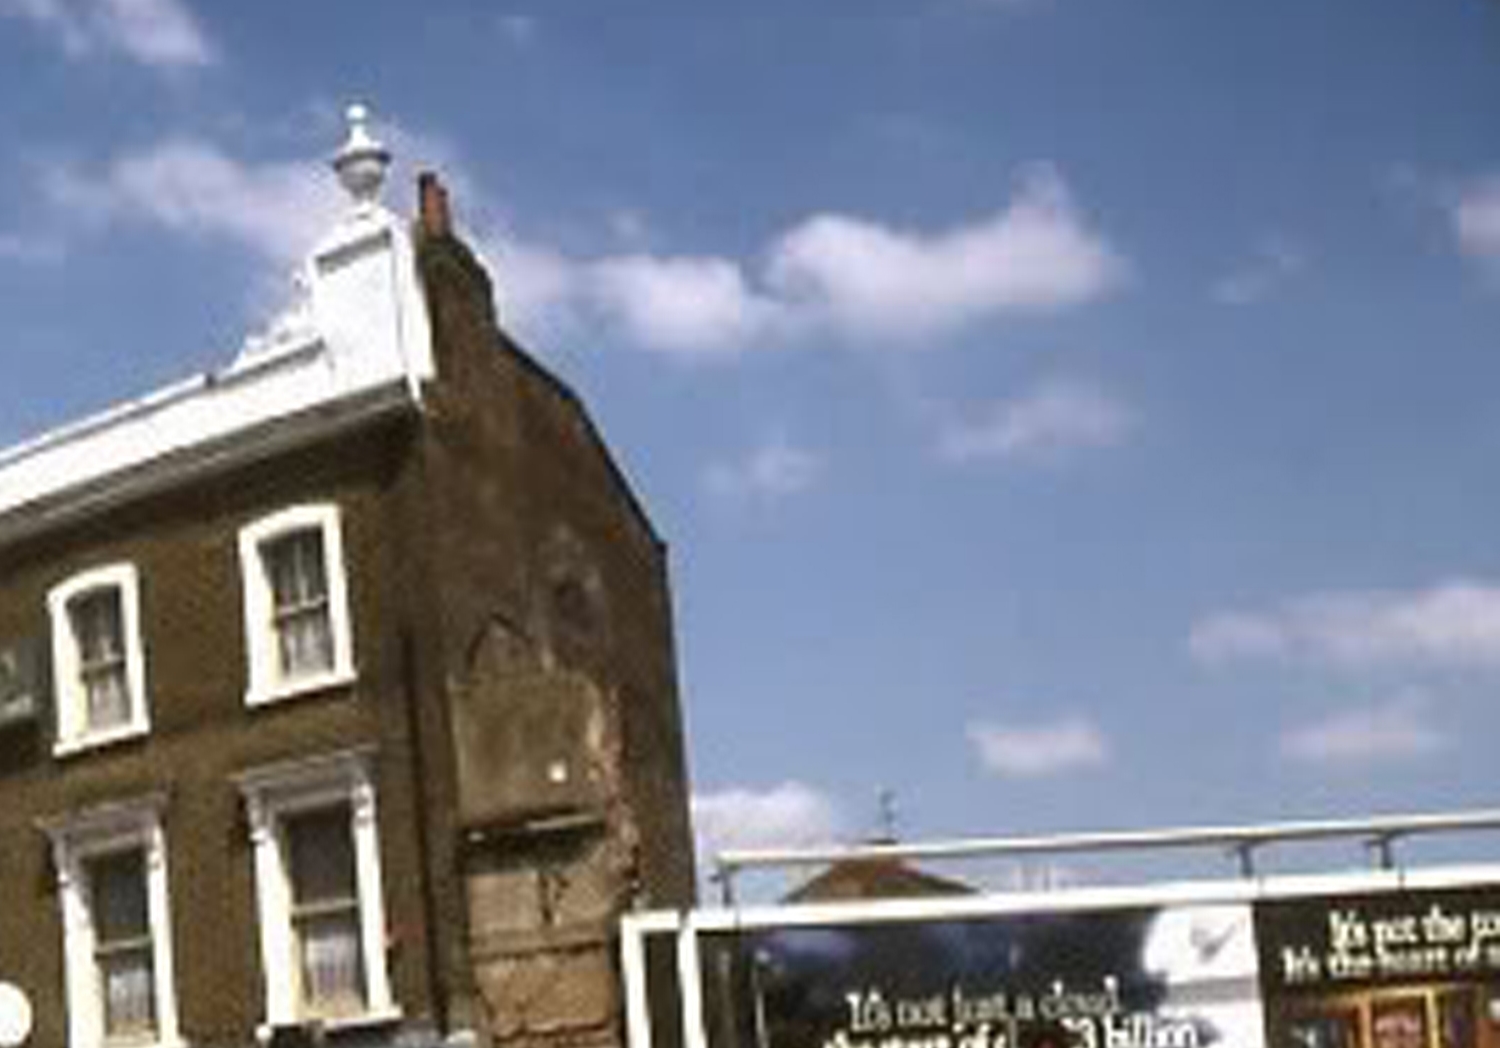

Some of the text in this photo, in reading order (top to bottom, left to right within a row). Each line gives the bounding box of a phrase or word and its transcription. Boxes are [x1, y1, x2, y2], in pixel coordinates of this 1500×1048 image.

[1422, 903, 1466, 943] the
[846, 987, 891, 1032] It's
[898, 995, 948, 1027] not
